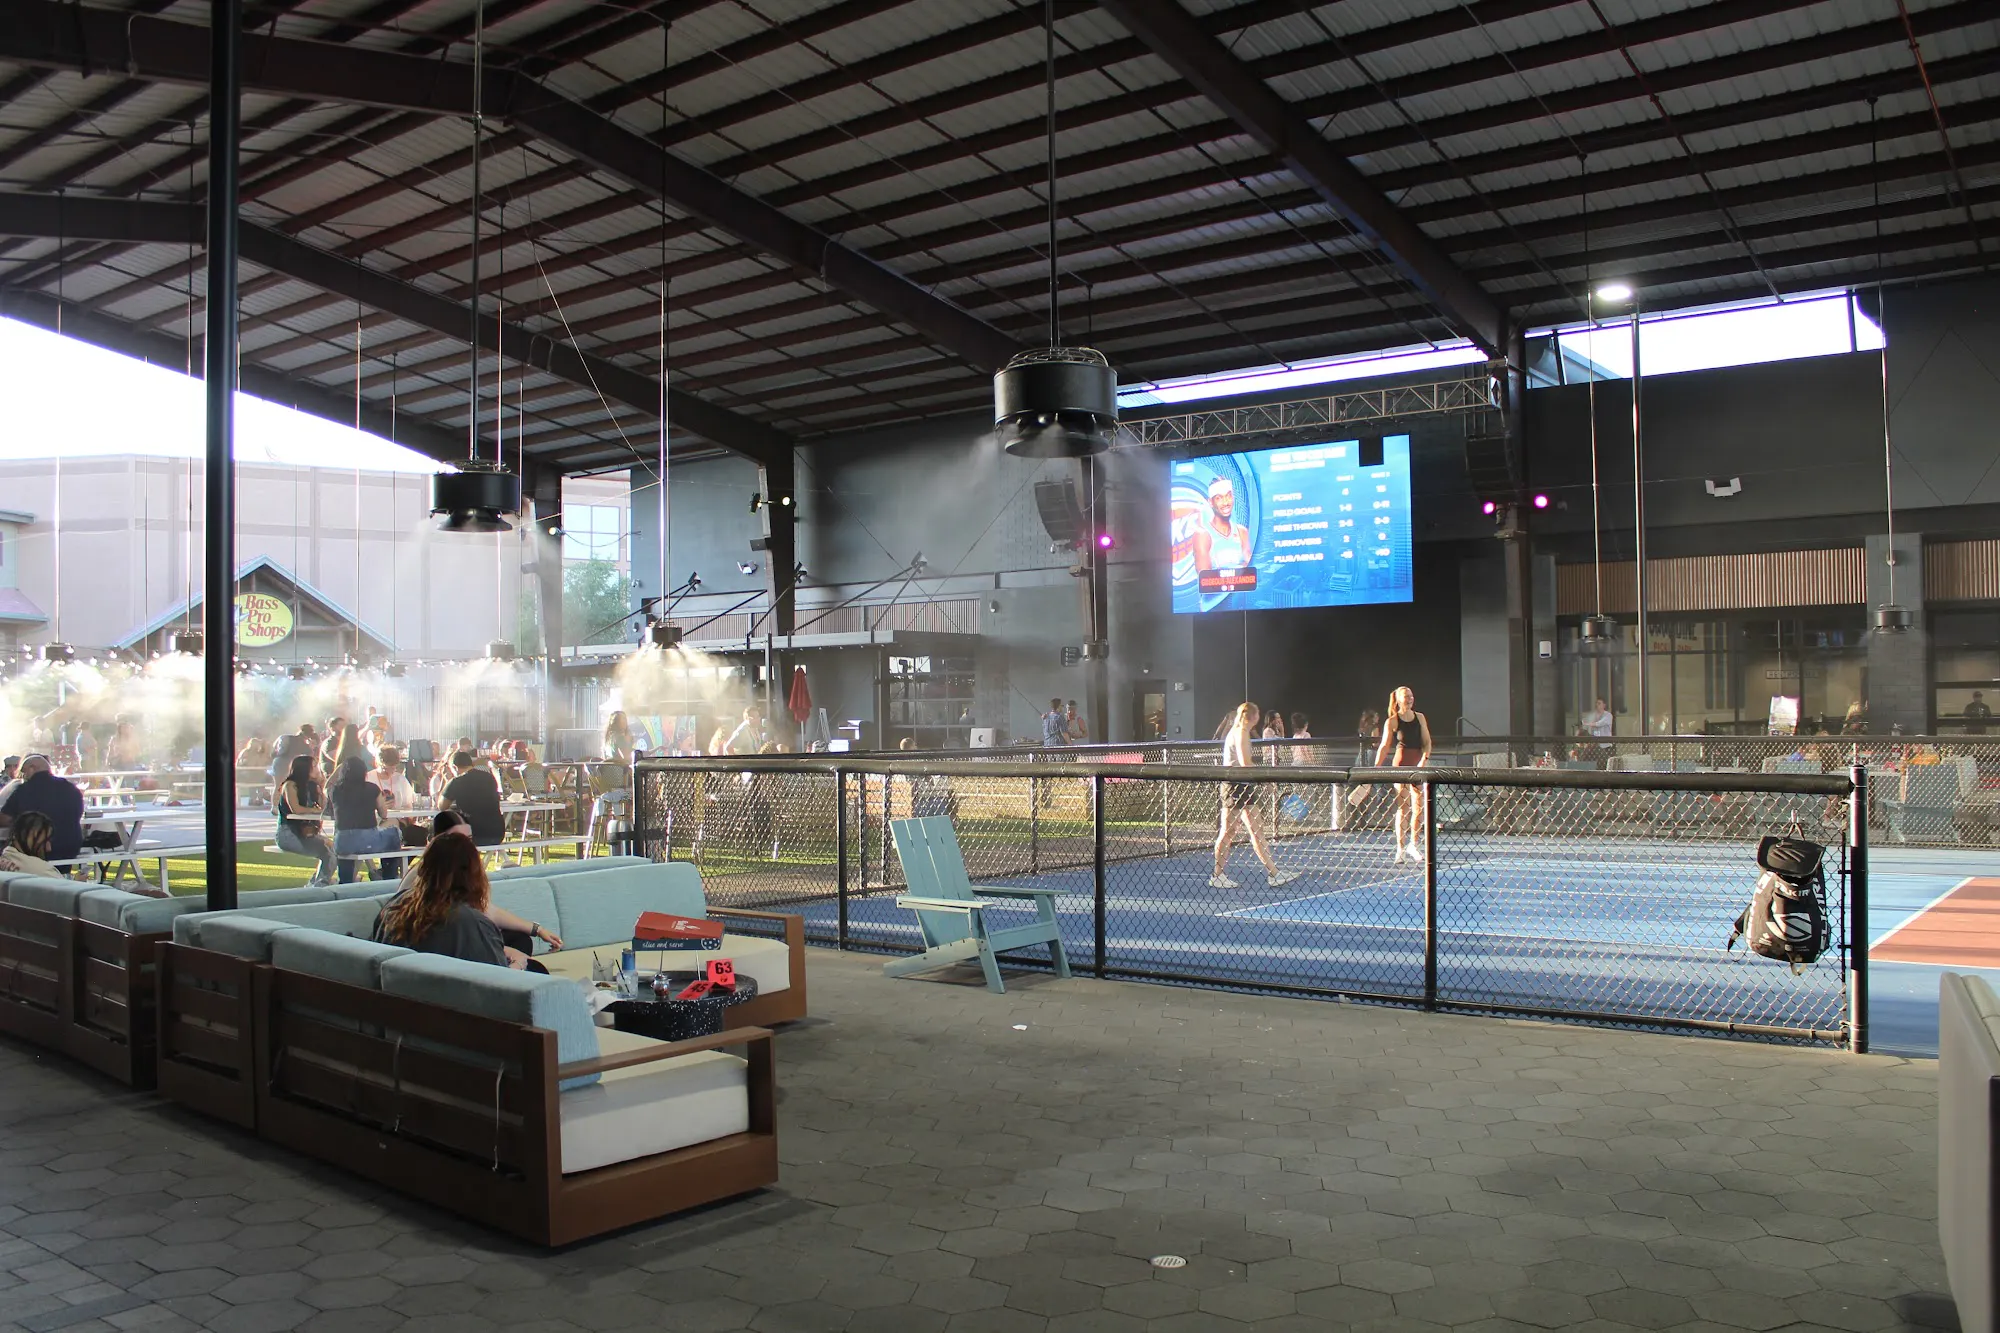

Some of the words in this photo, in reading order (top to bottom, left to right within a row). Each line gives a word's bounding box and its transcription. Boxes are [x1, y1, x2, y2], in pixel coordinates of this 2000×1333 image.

[1272, 493, 1302, 502] POINTS
[1273, 508, 1293, 517] FIELD
[1294, 505, 1323, 515] GOALS
[1273, 523, 1292, 533] FREE
[1293, 521, 1329, 531] THROWS
[1274, 537, 1322, 548] TURNOVERS
[1274, 552, 1324, 563] PLUS/MINUS
[245, 595, 279, 610] Bass
[247, 610, 272, 623] Pro
[246, 623, 287, 640] Shops
[656, 941, 668, 949] and
[715, 961, 732, 974] 63
[692, 983, 708, 993] 45
